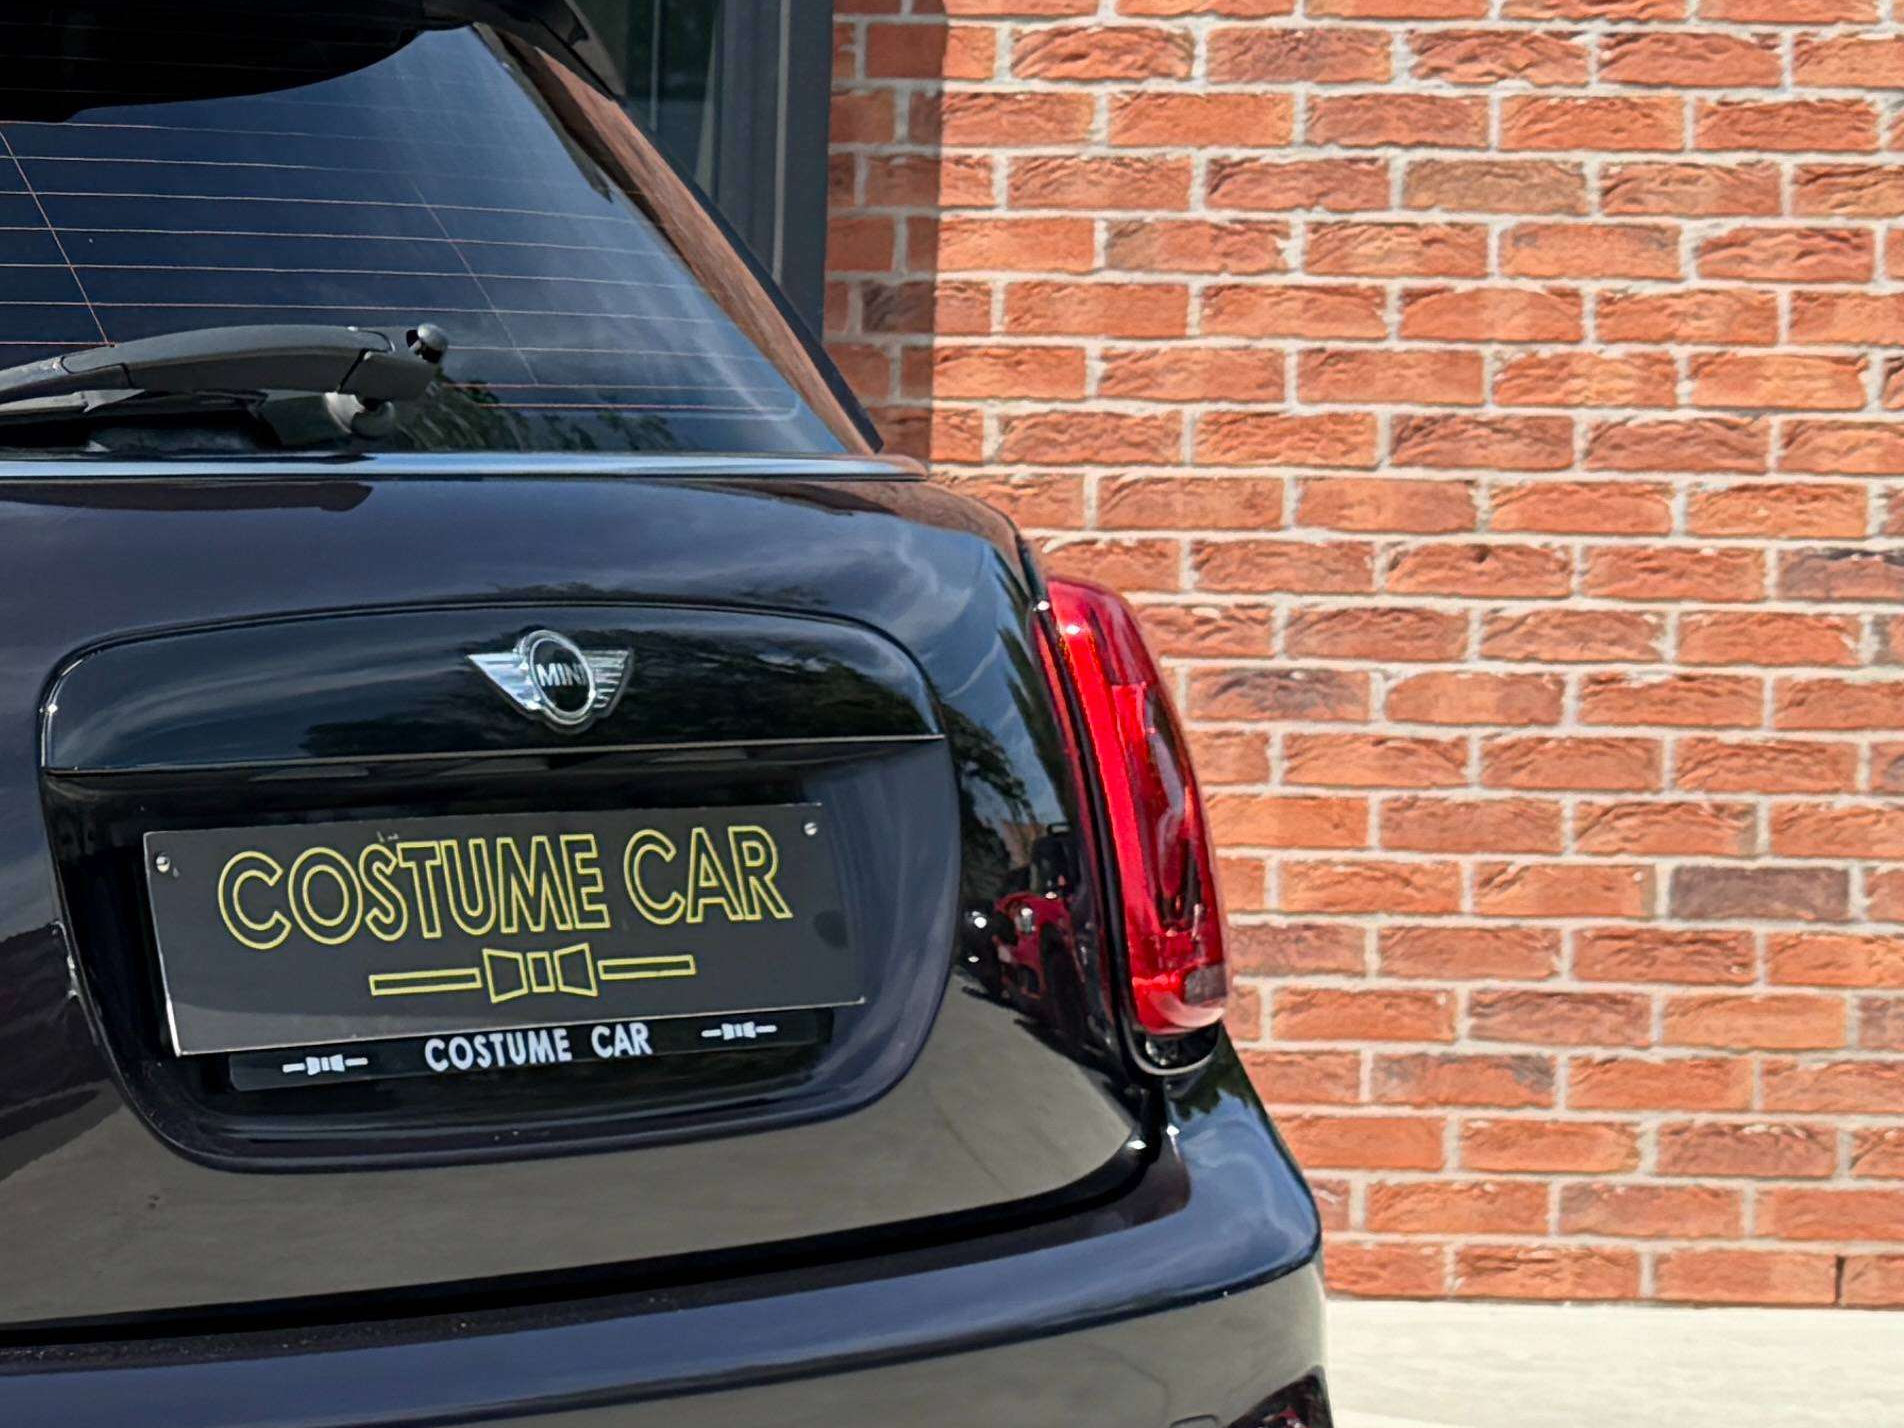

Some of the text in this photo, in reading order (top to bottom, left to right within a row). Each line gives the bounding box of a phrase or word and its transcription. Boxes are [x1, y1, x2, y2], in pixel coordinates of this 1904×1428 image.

[534, 662, 587, 687] MINI
[218, 825, 793, 949] COSTUME CAR
[424, 1022, 653, 1072] COSTUME CAR
